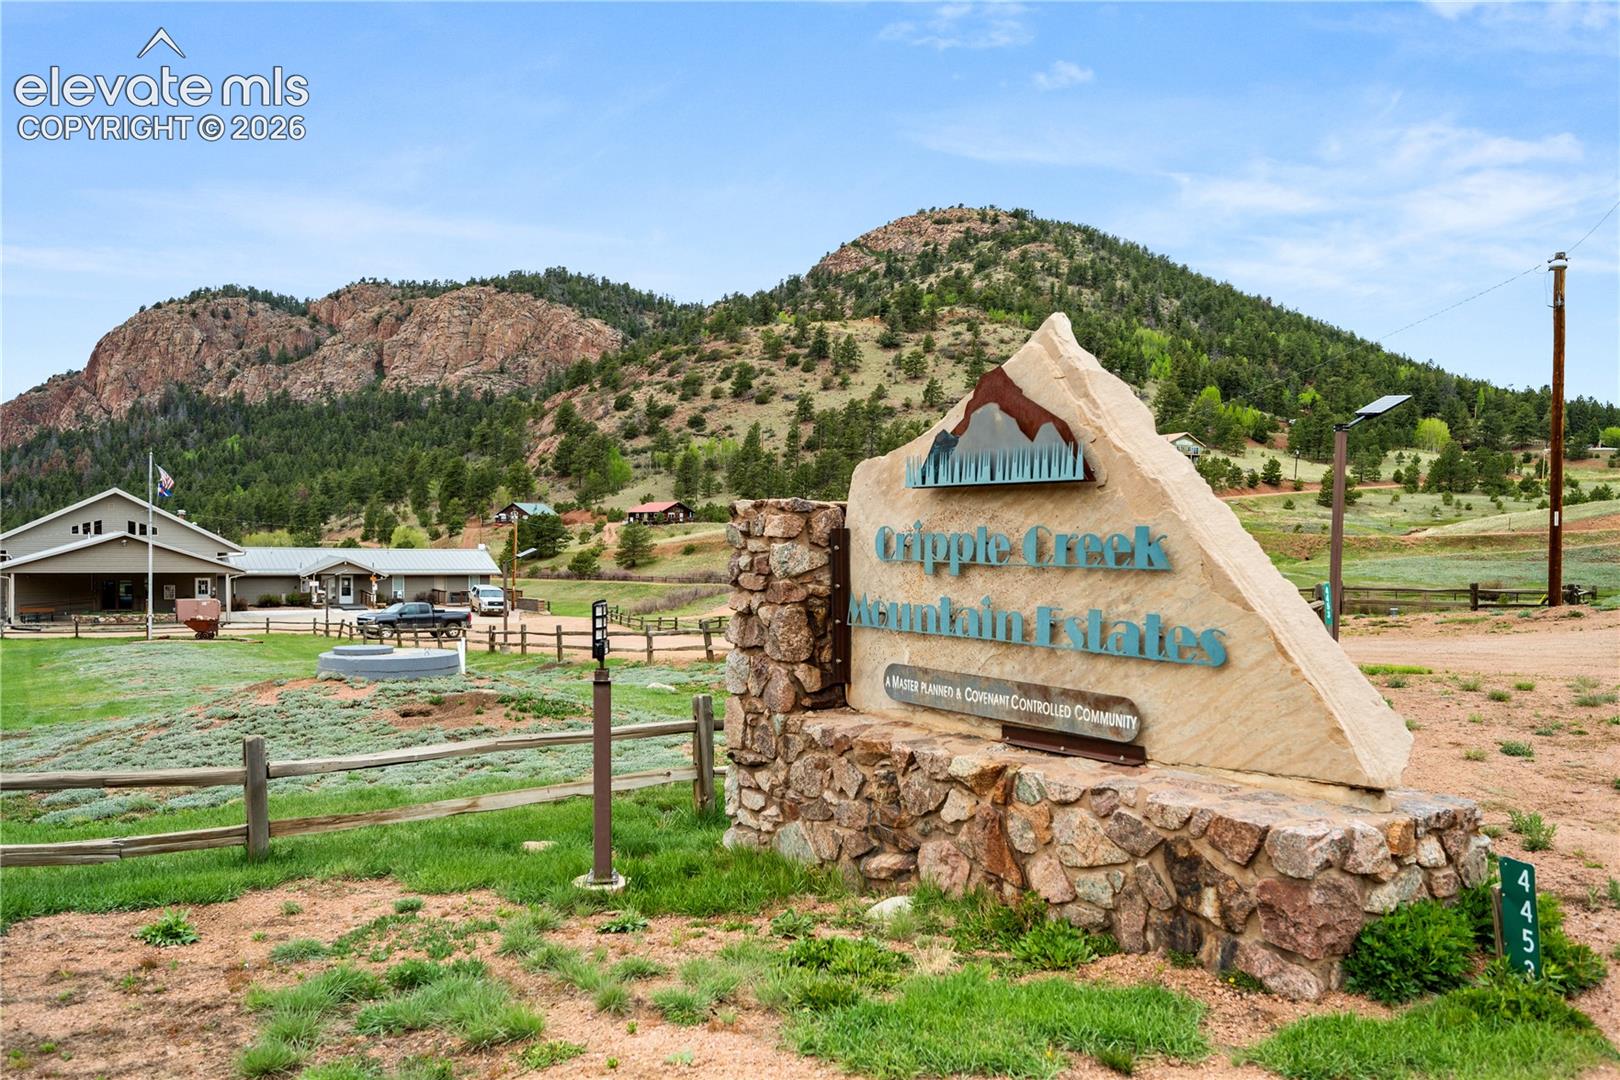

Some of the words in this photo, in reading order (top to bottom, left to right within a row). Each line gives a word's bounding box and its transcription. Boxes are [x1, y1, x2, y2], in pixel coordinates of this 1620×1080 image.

[875, 519, 1012, 576] Cripple
[1022, 525, 1173, 571] Creek
[847, 592, 1024, 644] Mountain
[1036, 606, 1229, 668] Estates
[885, 676, 891, 687] A
[955, 687, 962, 700] &
